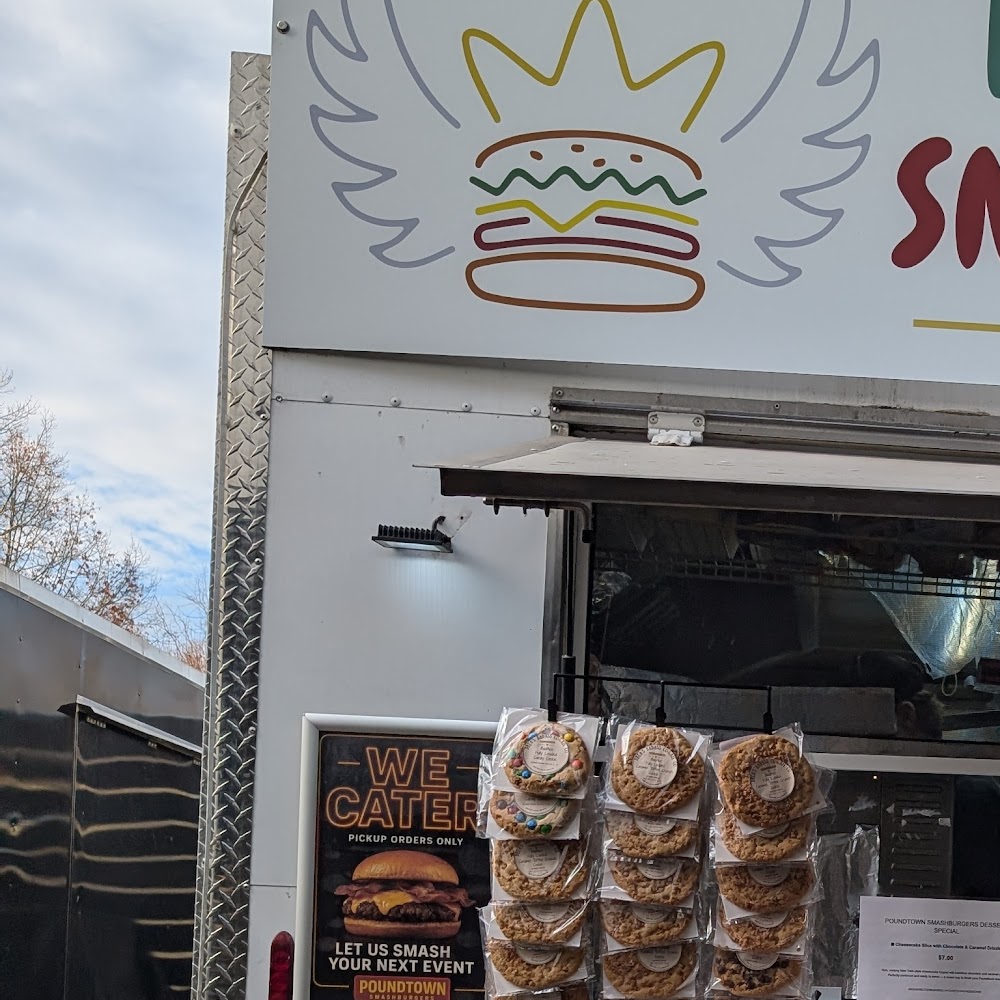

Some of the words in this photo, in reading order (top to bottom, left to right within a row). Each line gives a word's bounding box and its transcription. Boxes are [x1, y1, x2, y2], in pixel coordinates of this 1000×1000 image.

[366, 747, 450, 788] WE
[326, 787, 478, 830] CATER
[348, 834, 387, 844] PICKUP
[390, 835, 433, 846] ORDERS
[436, 837, 464, 846] ONLY
[885, 918, 926, 926] POUNDTOWN
[927, 919, 979, 927] SMASHBURGERS
[336, 942, 363, 956] LET
[368, 943, 388, 956] US
[392, 944, 450, 958] SMASH
[329, 957, 372, 971] YOUR
[376, 958, 417, 972] NEXT
[423, 960, 474, 974] EVENT
[359, 980, 446, 996] POUNDTOWN
